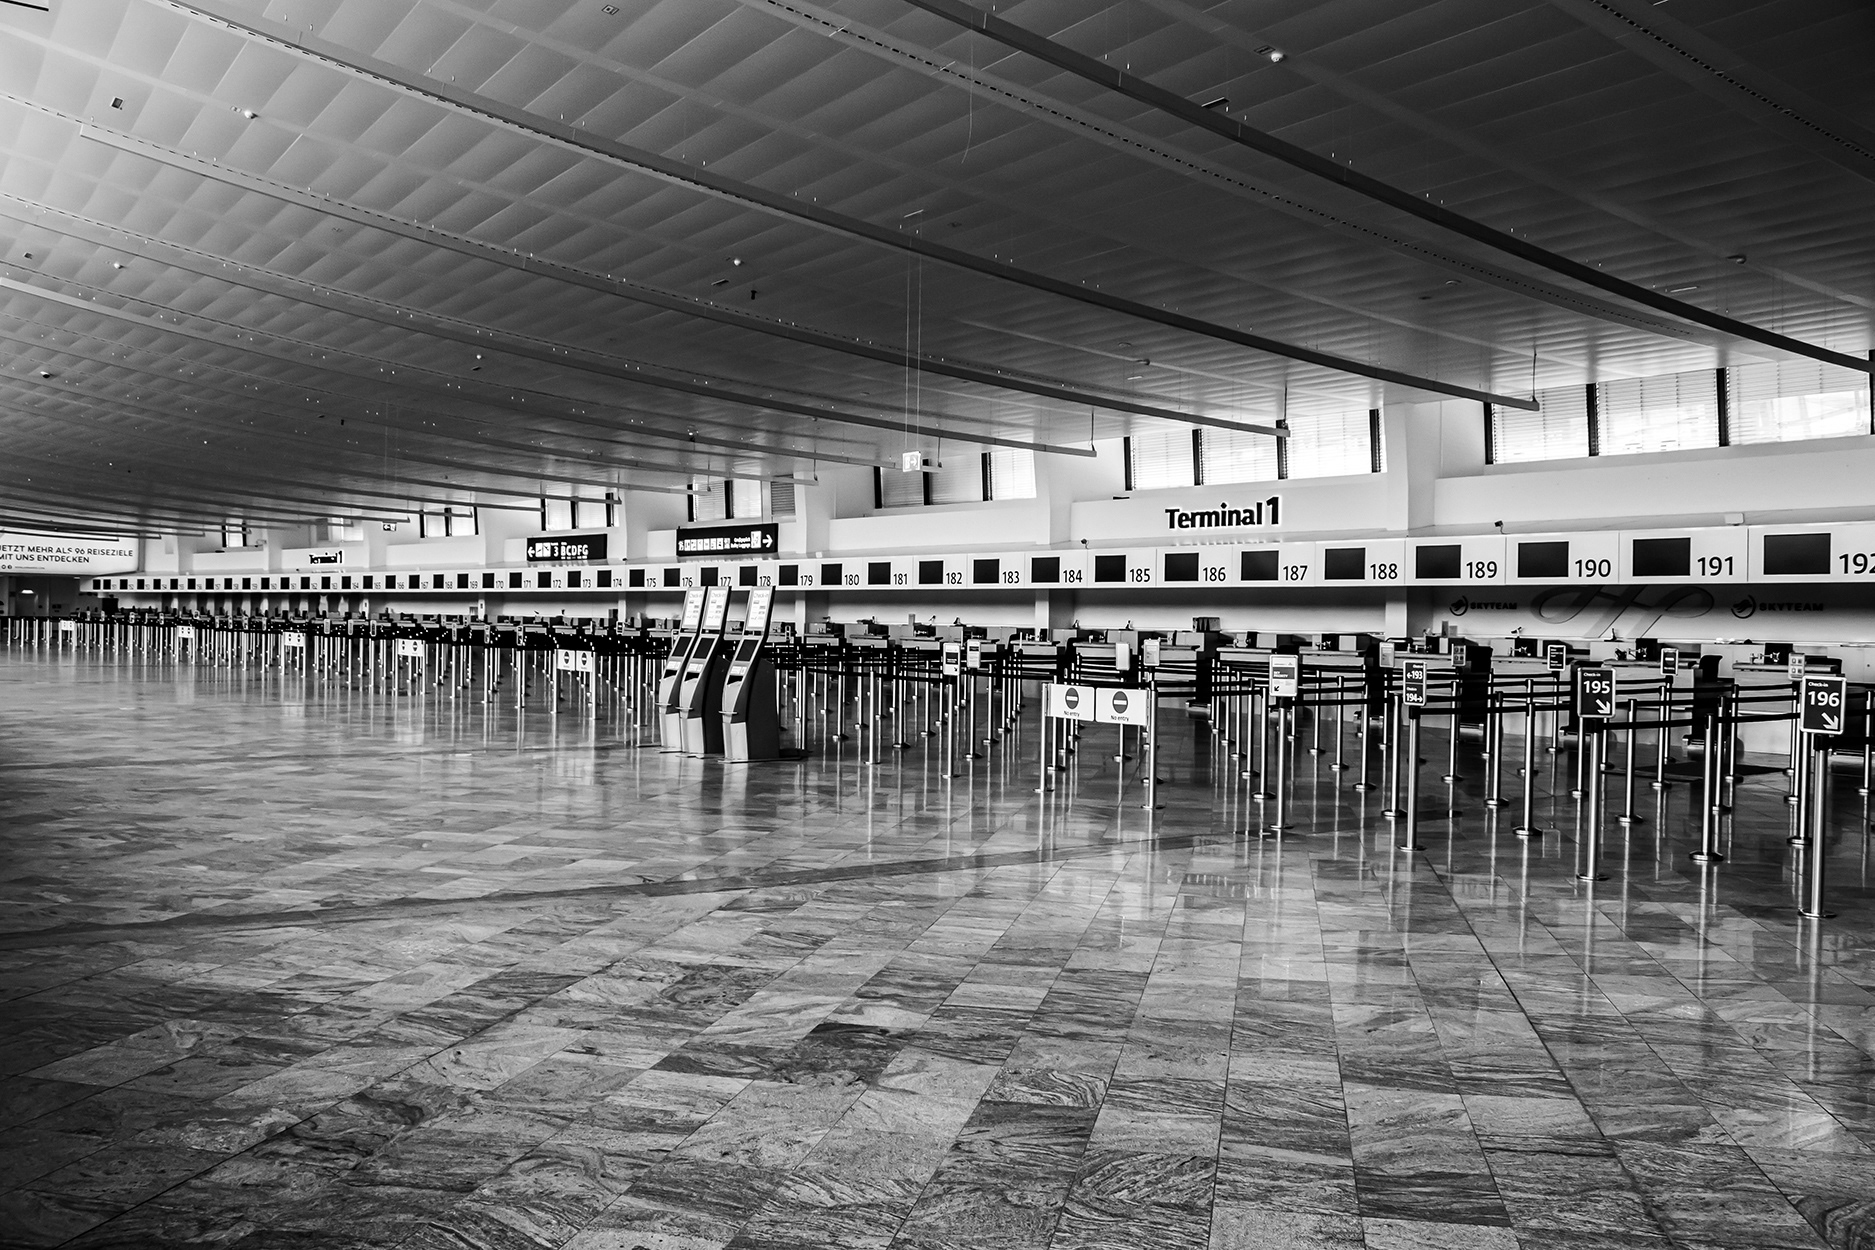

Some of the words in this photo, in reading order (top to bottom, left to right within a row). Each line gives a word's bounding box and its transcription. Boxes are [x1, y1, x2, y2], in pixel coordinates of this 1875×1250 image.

[1164, 501, 1263, 529] Terminal
[1265, 496, 1280, 526] 1
[27, 545, 54, 555] MEHR
[55, 547, 73, 555] ALS
[74, 547, 86, 556] 96
[87, 548, 134, 557] REISEZIELE
[15, 553, 36, 562] UNS
[36, 554, 90, 564] ENTDECKEN
[1369, 563, 1399, 580] 188
[1466, 560, 1498, 579] 189
[1574, 558, 1612, 578] 190
[1697, 556, 1734, 576] 191
[844, 573, 860, 586] 180
[893, 573, 908, 586] 181
[945, 572, 963, 585] 182
[1002, 570, 1021, 585] 183
[1062, 569, 1083, 584] 184
[1129, 568, 1152, 583] 185
[1202, 566, 1227, 582] 186
[1282, 565, 1308, 581] 187
[495, 580, 504, 589] 170
[523, 579, 532, 588] 171
[553, 579, 562, 589] 172
[582, 578, 592, 588] 173
[612, 578, 623, 588] 174
[646, 577, 657, 588] 175
[682, 576, 693, 588] 176
[720, 576, 732, 588] 177
[759, 575, 772, 587] 178
[800, 574, 814, 587] 179
[1469, 602, 1518, 610] SKYTEAM
[1758, 602, 1824, 611] SKYTEAM
[1411, 670, 1423, 680] 193
[1583, 680, 1611, 694] 195
[1405, 692, 1418, 702] 194
[1807, 690, 1840, 707] 196
